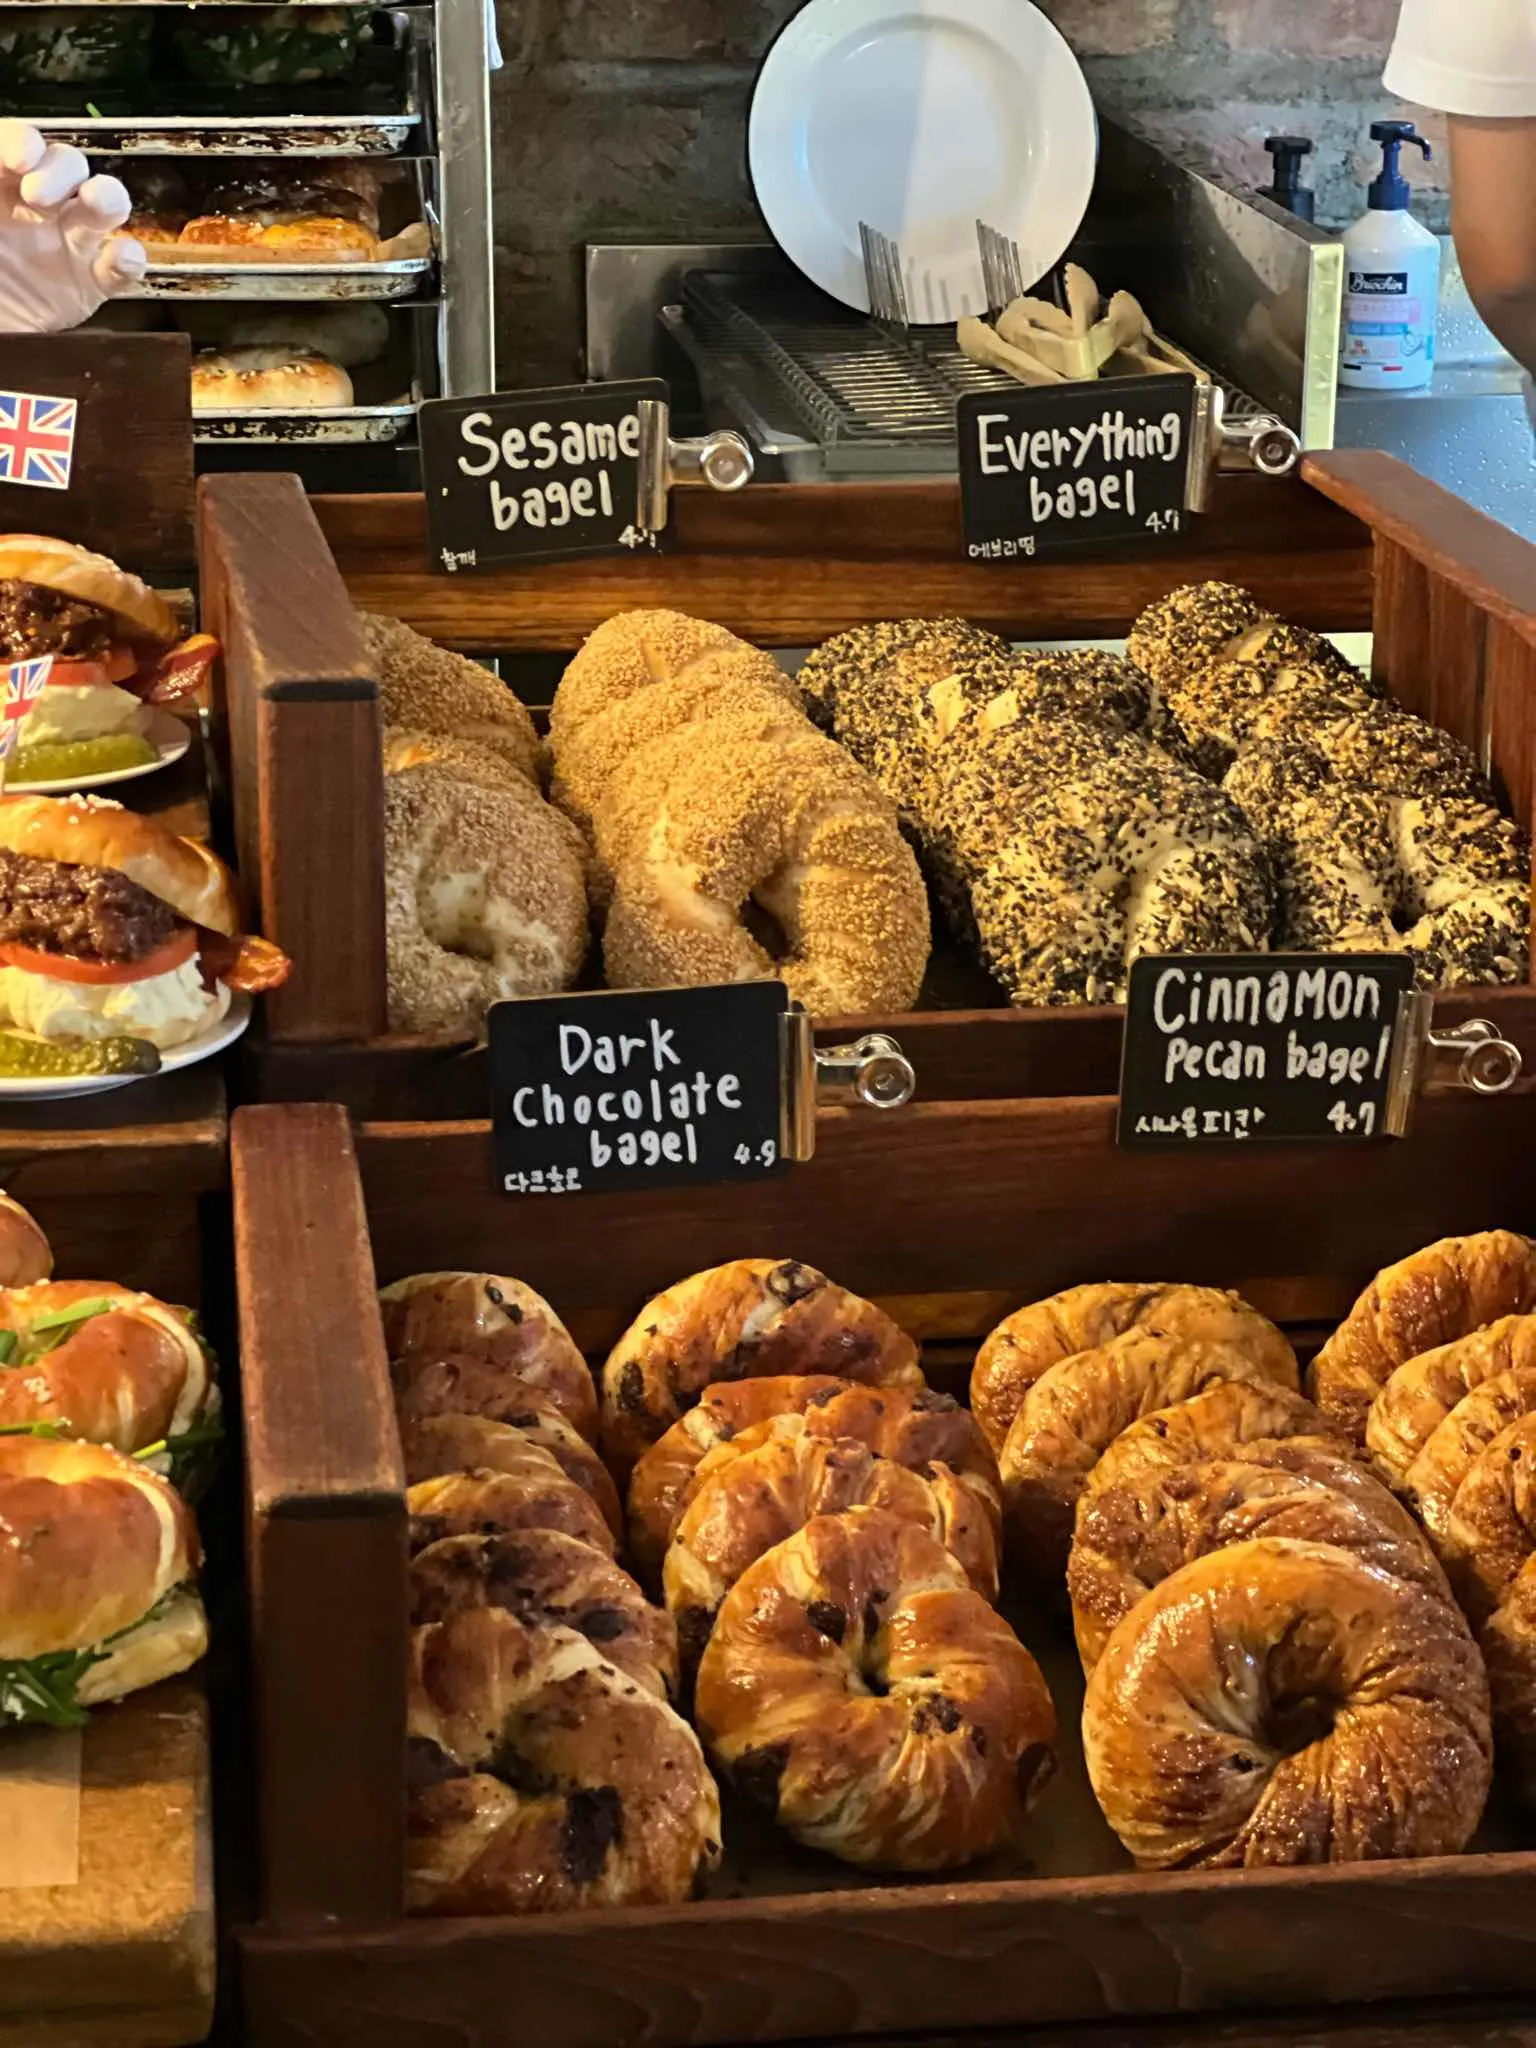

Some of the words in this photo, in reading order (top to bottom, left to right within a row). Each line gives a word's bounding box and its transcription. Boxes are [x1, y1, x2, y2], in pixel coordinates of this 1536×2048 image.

[457, 412, 640, 476] Sesame
[976, 410, 1181, 475] Everything
[489, 470, 614, 531] bagel
[1030, 469, 1136, 523] bagel
[559, 1018, 681, 1076] Dark
[1286, 1025, 1392, 1085] bagel
[590, 1123, 698, 1168] bagel
[1326, 1100, 1376, 1136] 4.7
[733, 1139, 776, 1167] 4.9
